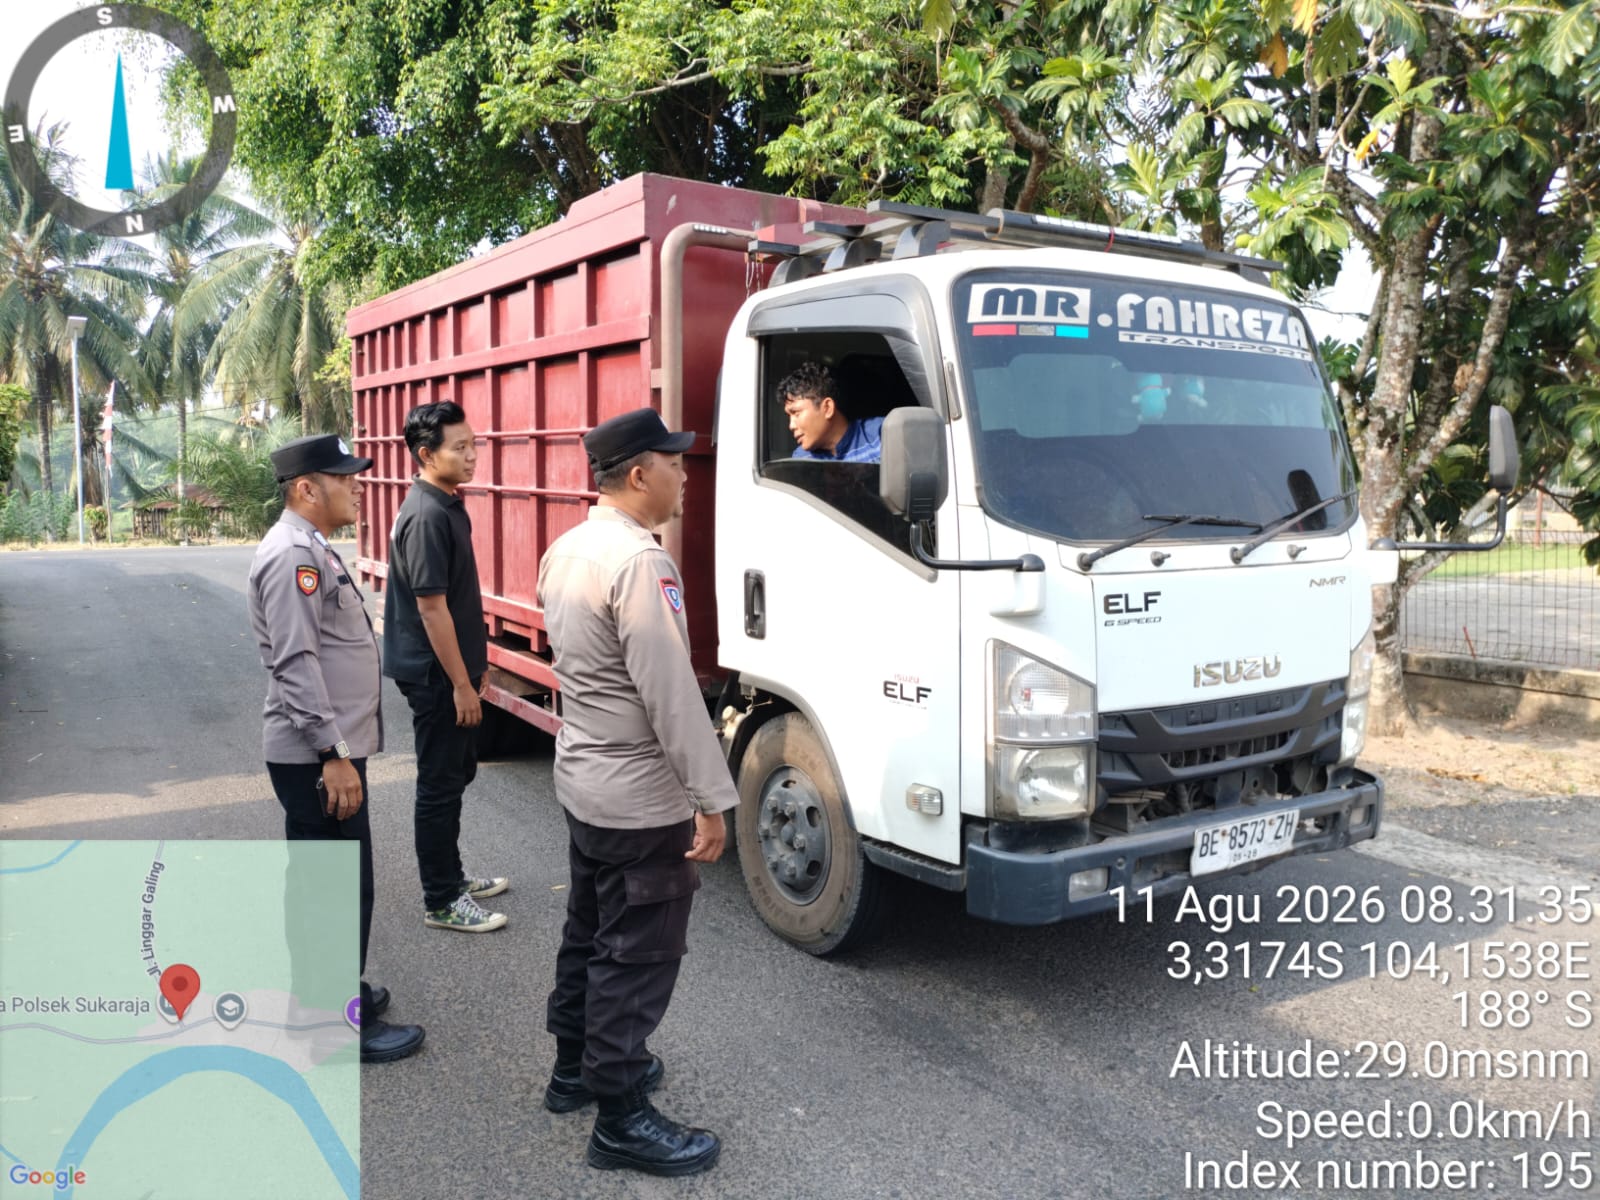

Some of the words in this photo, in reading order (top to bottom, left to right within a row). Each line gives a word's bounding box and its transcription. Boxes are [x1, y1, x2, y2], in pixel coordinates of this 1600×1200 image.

[1121, 332, 1310, 358] TRANSPORT
[1309, 576, 1346, 588] NMR
[1103, 591, 1162, 614] ELF
[1117, 616, 1162, 626] SPEED
[1193, 655, 1281, 688] ISUZU
[883, 680, 932, 703] ELF
[1199, 829, 1220, 857] BE
[1228, 819, 1266, 850] 8573
[1273, 813, 1295, 840] ZH
